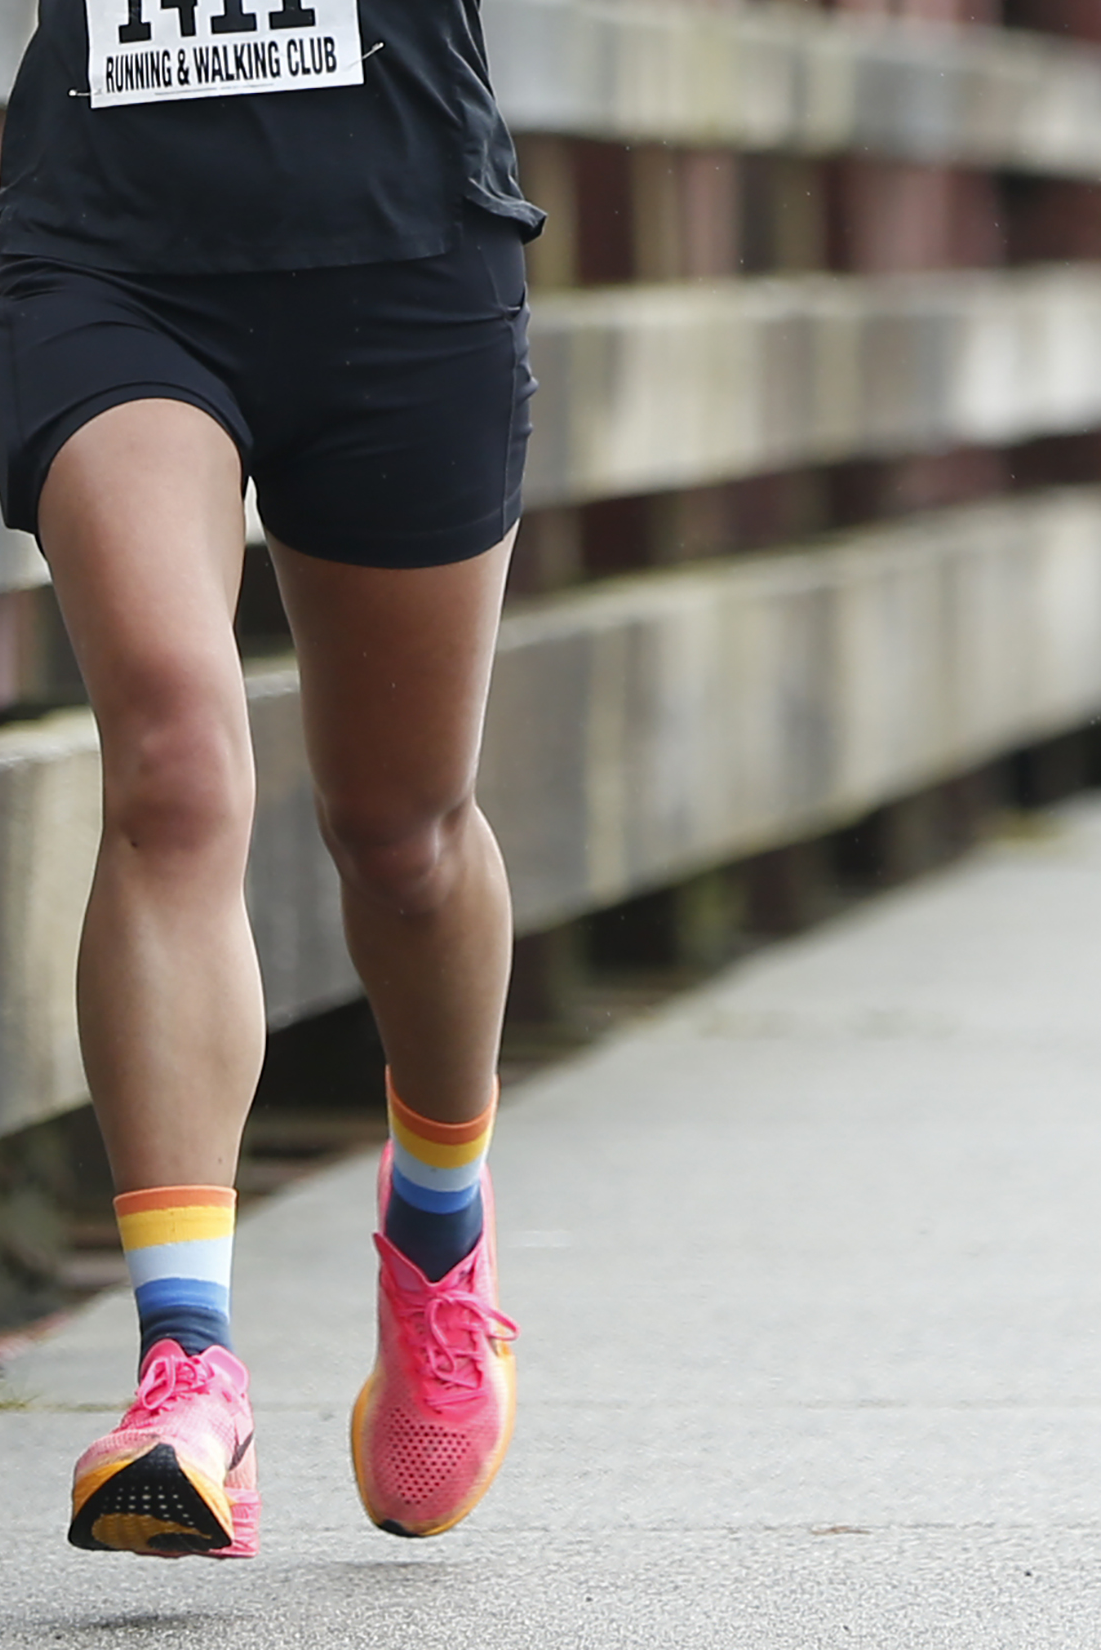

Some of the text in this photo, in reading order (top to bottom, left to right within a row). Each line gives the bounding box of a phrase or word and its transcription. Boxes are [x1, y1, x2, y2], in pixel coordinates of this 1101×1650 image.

[106, 36, 337, 93] RUNNING & WALKING CLUB
